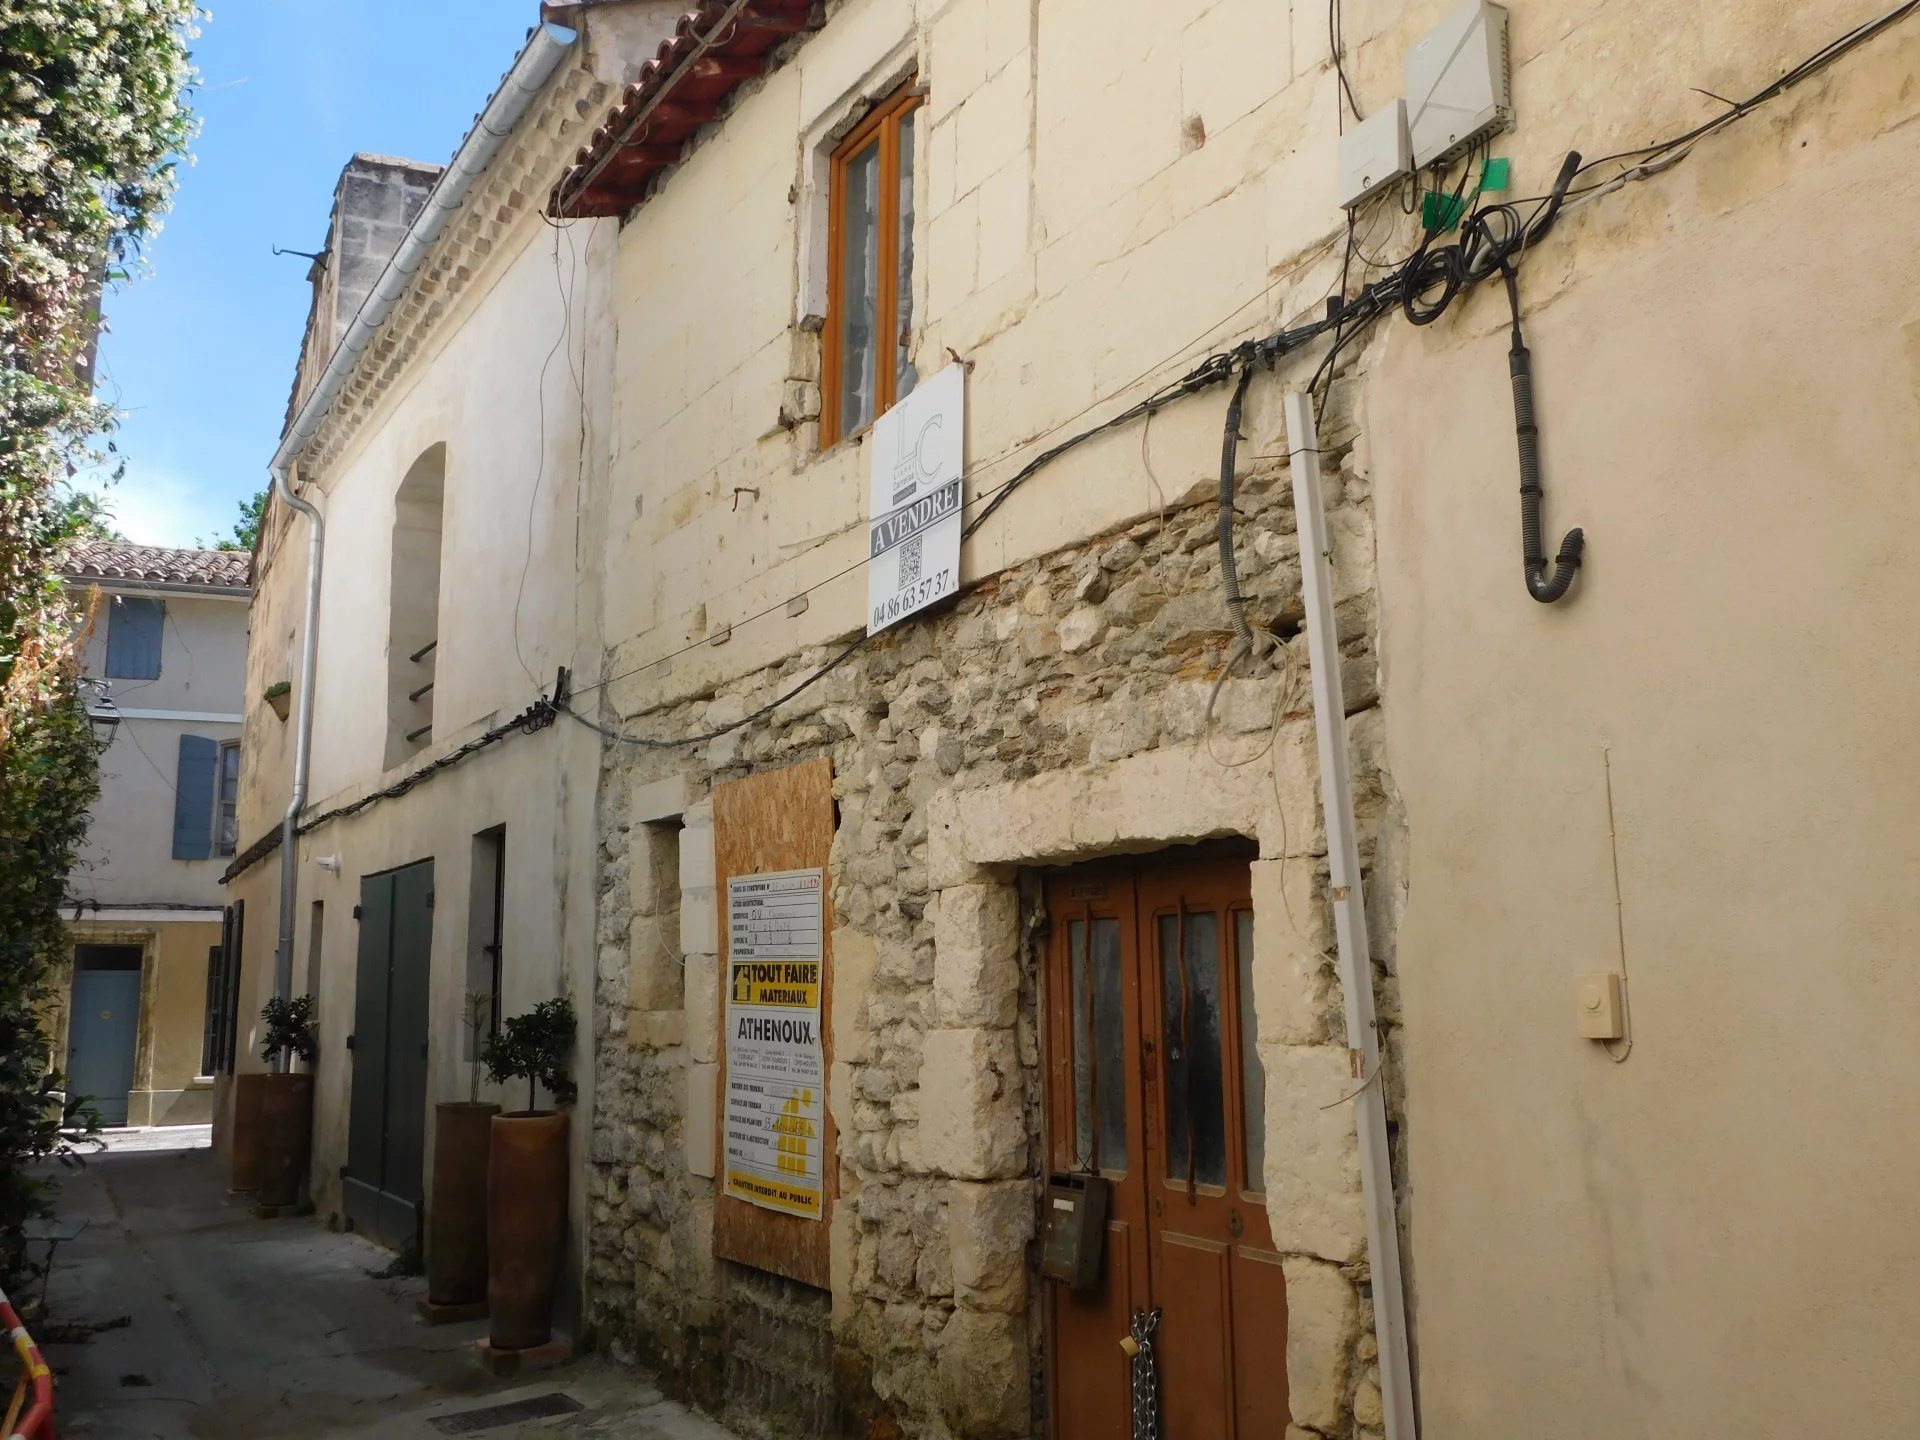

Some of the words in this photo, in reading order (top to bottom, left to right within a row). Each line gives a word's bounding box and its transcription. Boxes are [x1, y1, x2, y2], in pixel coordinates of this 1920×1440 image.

[874, 526, 886, 554] A
[887, 484, 954, 543] VENDRE
[873, 602, 885, 627] 04
[887, 594, 900, 619] 86
[902, 586, 915, 611] 63
[918, 577, 932, 604] 57
[934, 568, 949, 595] 37
[751, 964, 782, 983] TOUT
[784, 964, 817, 984] FAIRE
[760, 988, 807, 1004] MATERIAUX
[737, 1017, 813, 1045] ATHENOUX
[754, 1185, 777, 1198] INTERDIT
[778, 1191, 787, 1200] AU
[789, 1192, 812, 1205] PUBLIC
